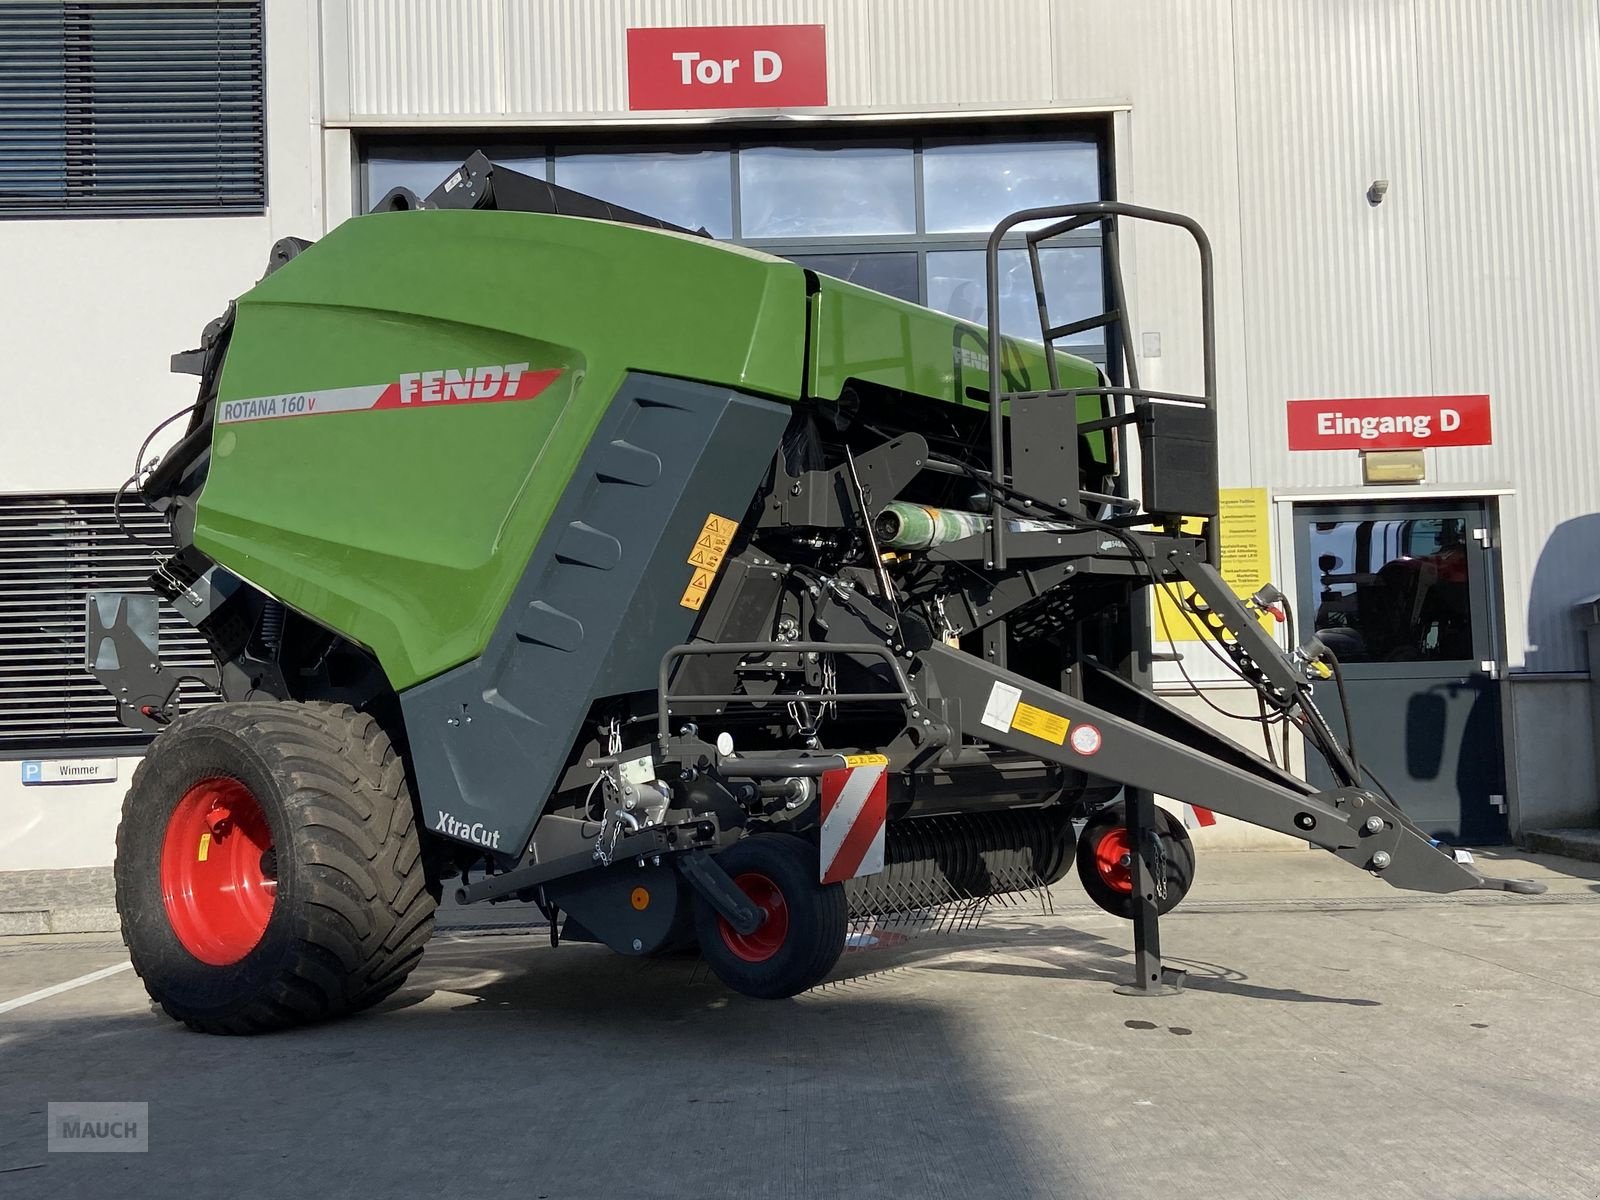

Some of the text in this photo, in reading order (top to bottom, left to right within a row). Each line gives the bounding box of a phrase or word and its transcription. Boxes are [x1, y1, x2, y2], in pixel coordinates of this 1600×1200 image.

[672, 51, 783, 85] Tor D
[399, 362, 530, 404] FENDT
[225, 399, 276, 420] ROTANA
[281, 395, 305, 414] 160
[1317, 408, 1461, 440] Eingang D
[59, 765, 99, 776] Wimmer
[436, 810, 500, 849] XtraCut
